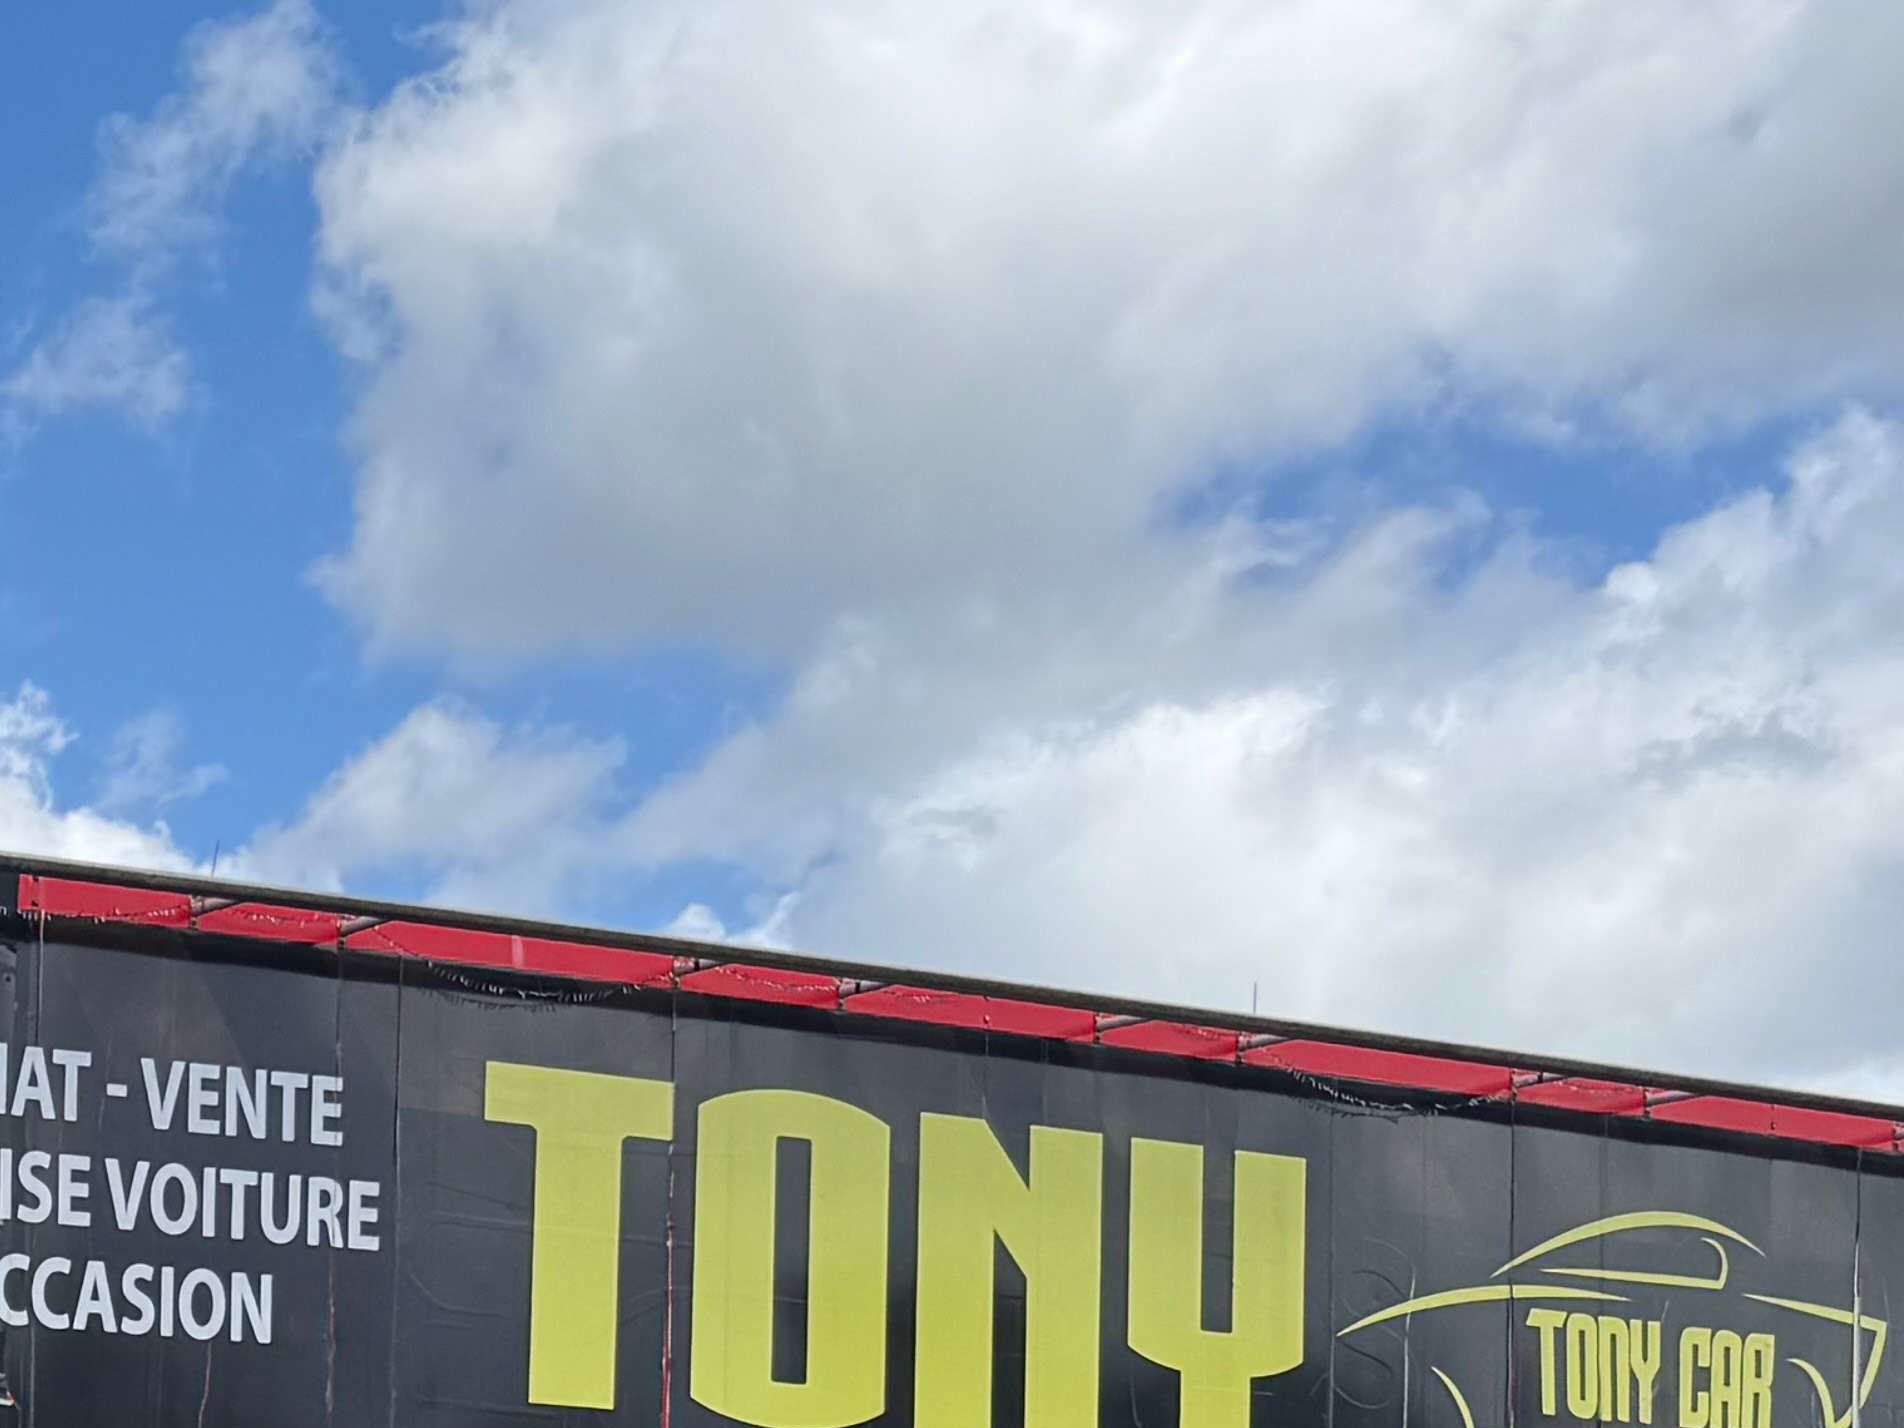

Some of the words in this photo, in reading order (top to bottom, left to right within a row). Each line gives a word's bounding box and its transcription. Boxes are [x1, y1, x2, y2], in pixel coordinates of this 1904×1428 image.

[141, 1058, 344, 1148] VENTE
[105, 1162, 381, 1252] VOITURE
[1526, 1308, 1661, 1424] TONY
